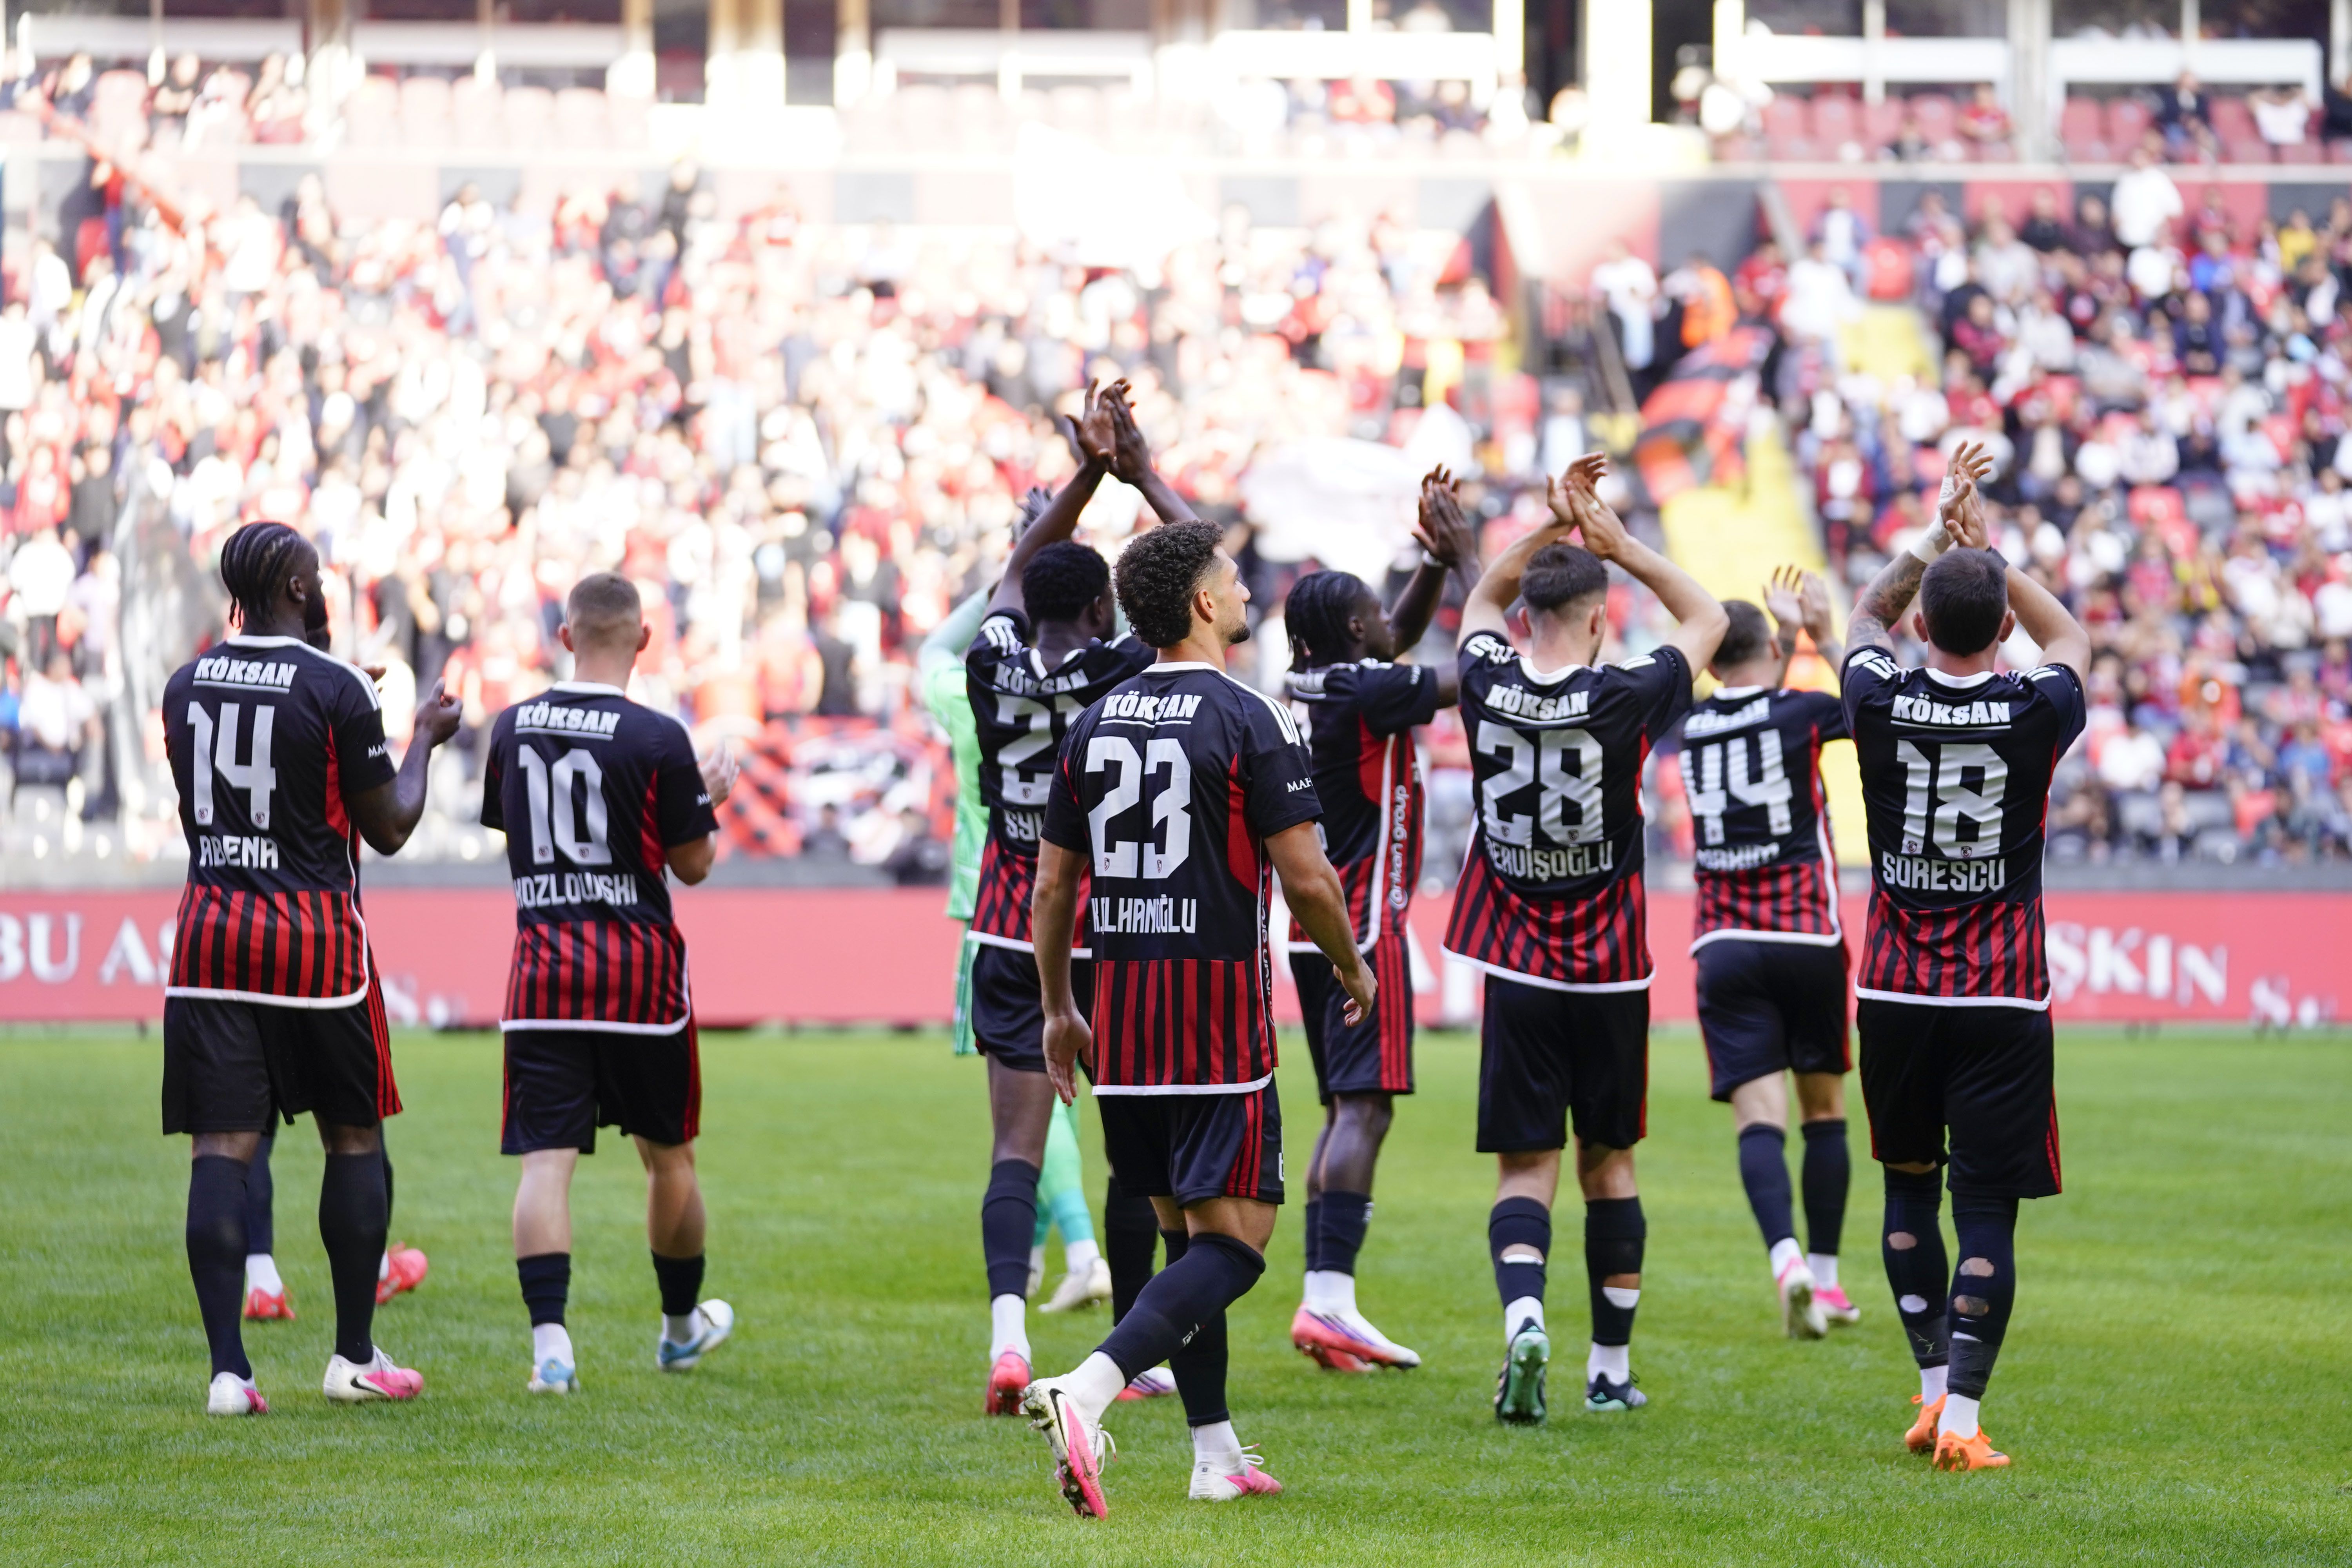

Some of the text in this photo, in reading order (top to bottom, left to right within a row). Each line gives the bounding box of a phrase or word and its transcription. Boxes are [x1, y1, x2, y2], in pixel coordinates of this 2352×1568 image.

[194, 657, 297, 688] KÖKSAN
[515, 701, 621, 734] KÖKSAN
[1101, 690, 1203, 721] KÖKSAN
[1485, 684, 1589, 720] KÖKSAN
[1891, 692, 2011, 725] KÖKSAN
[187, 701, 276, 830] 14
[996, 692, 1087, 805] 2
[518, 744, 612, 865] 10
[1085, 736, 1191, 879] 23
[1476, 720, 1603, 845] 28
[1678, 728, 1793, 846] 44
[1896, 739, 2008, 858] 18
[1392, 784, 1410, 841] group
[199, 835, 279, 870] ABENA
[1882, 850, 2005, 892] SORESCU
